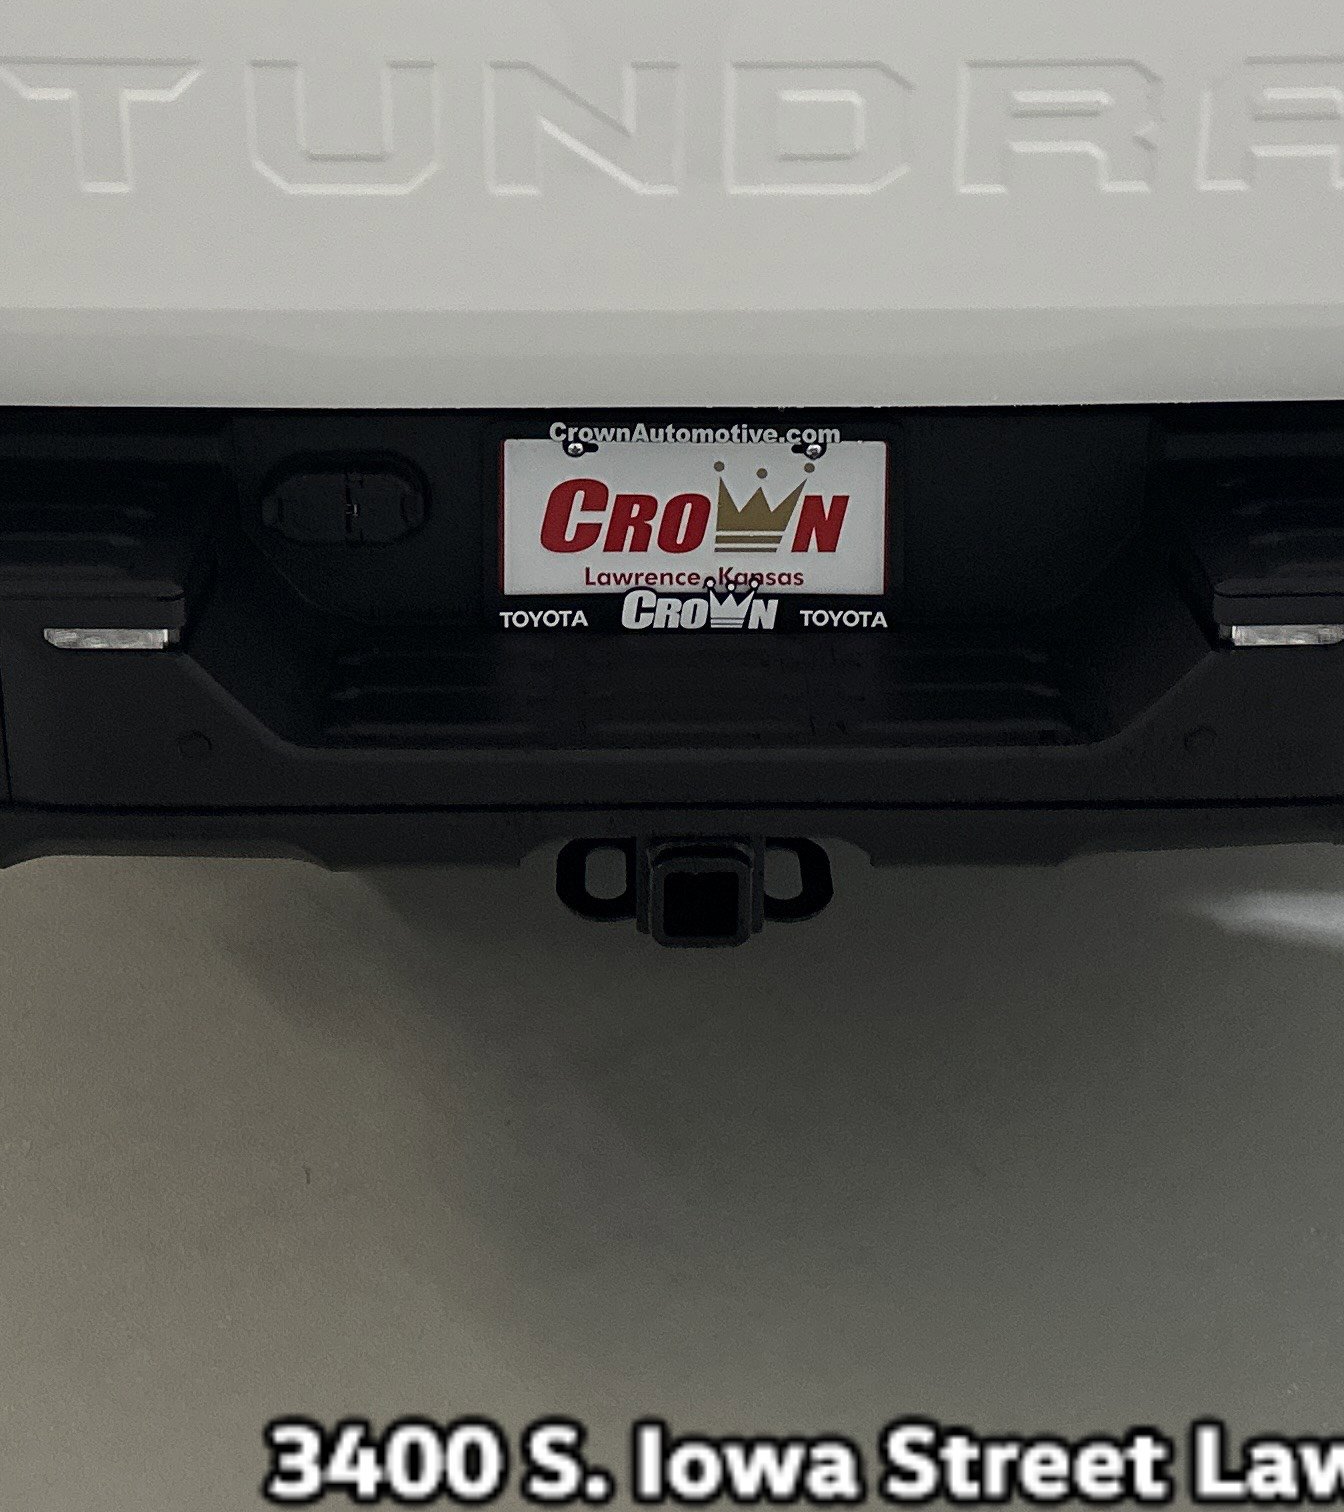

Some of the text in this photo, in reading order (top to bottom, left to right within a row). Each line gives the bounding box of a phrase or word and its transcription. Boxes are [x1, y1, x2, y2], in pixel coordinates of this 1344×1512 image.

[549, 421, 841, 444] CrownAutomotive.com
[540, 460, 850, 554] CROWN
[718, 567, 804, 587] Kansas
[499, 578, 888, 630] TOYOTA CROWN TOYOTA
